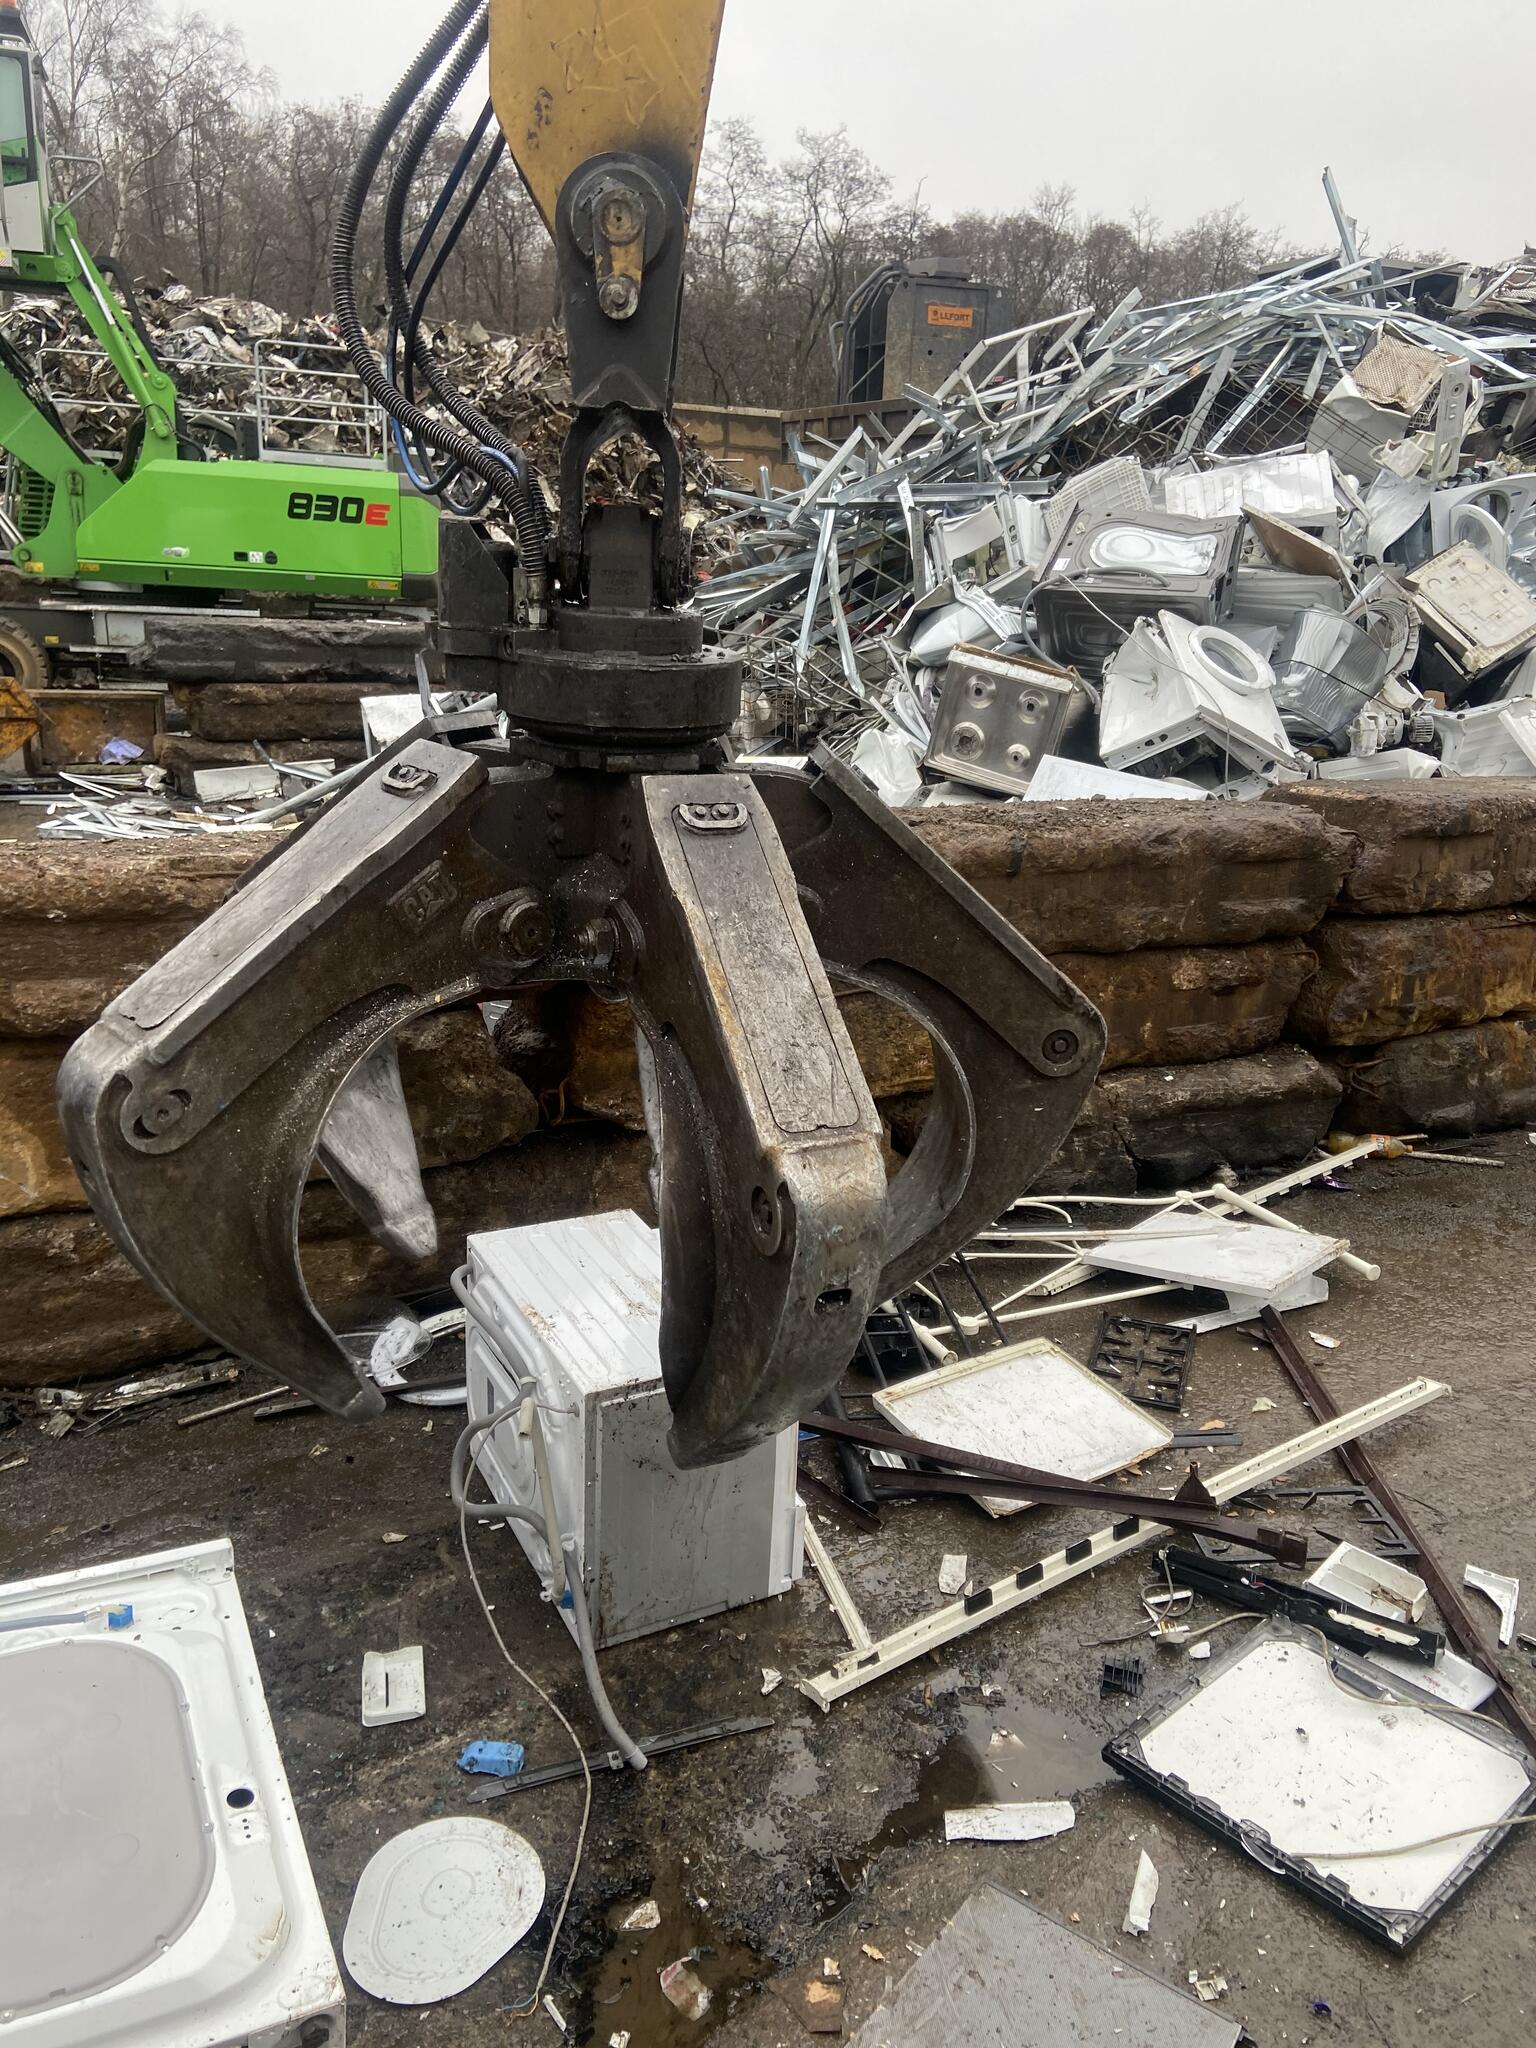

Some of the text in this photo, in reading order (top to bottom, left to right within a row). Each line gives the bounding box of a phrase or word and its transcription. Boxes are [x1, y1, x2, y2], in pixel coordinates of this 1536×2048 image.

[940, 311, 970, 321] LEFORT
[287, 492, 391, 526] 830E
[402, 870, 458, 923] CAT
